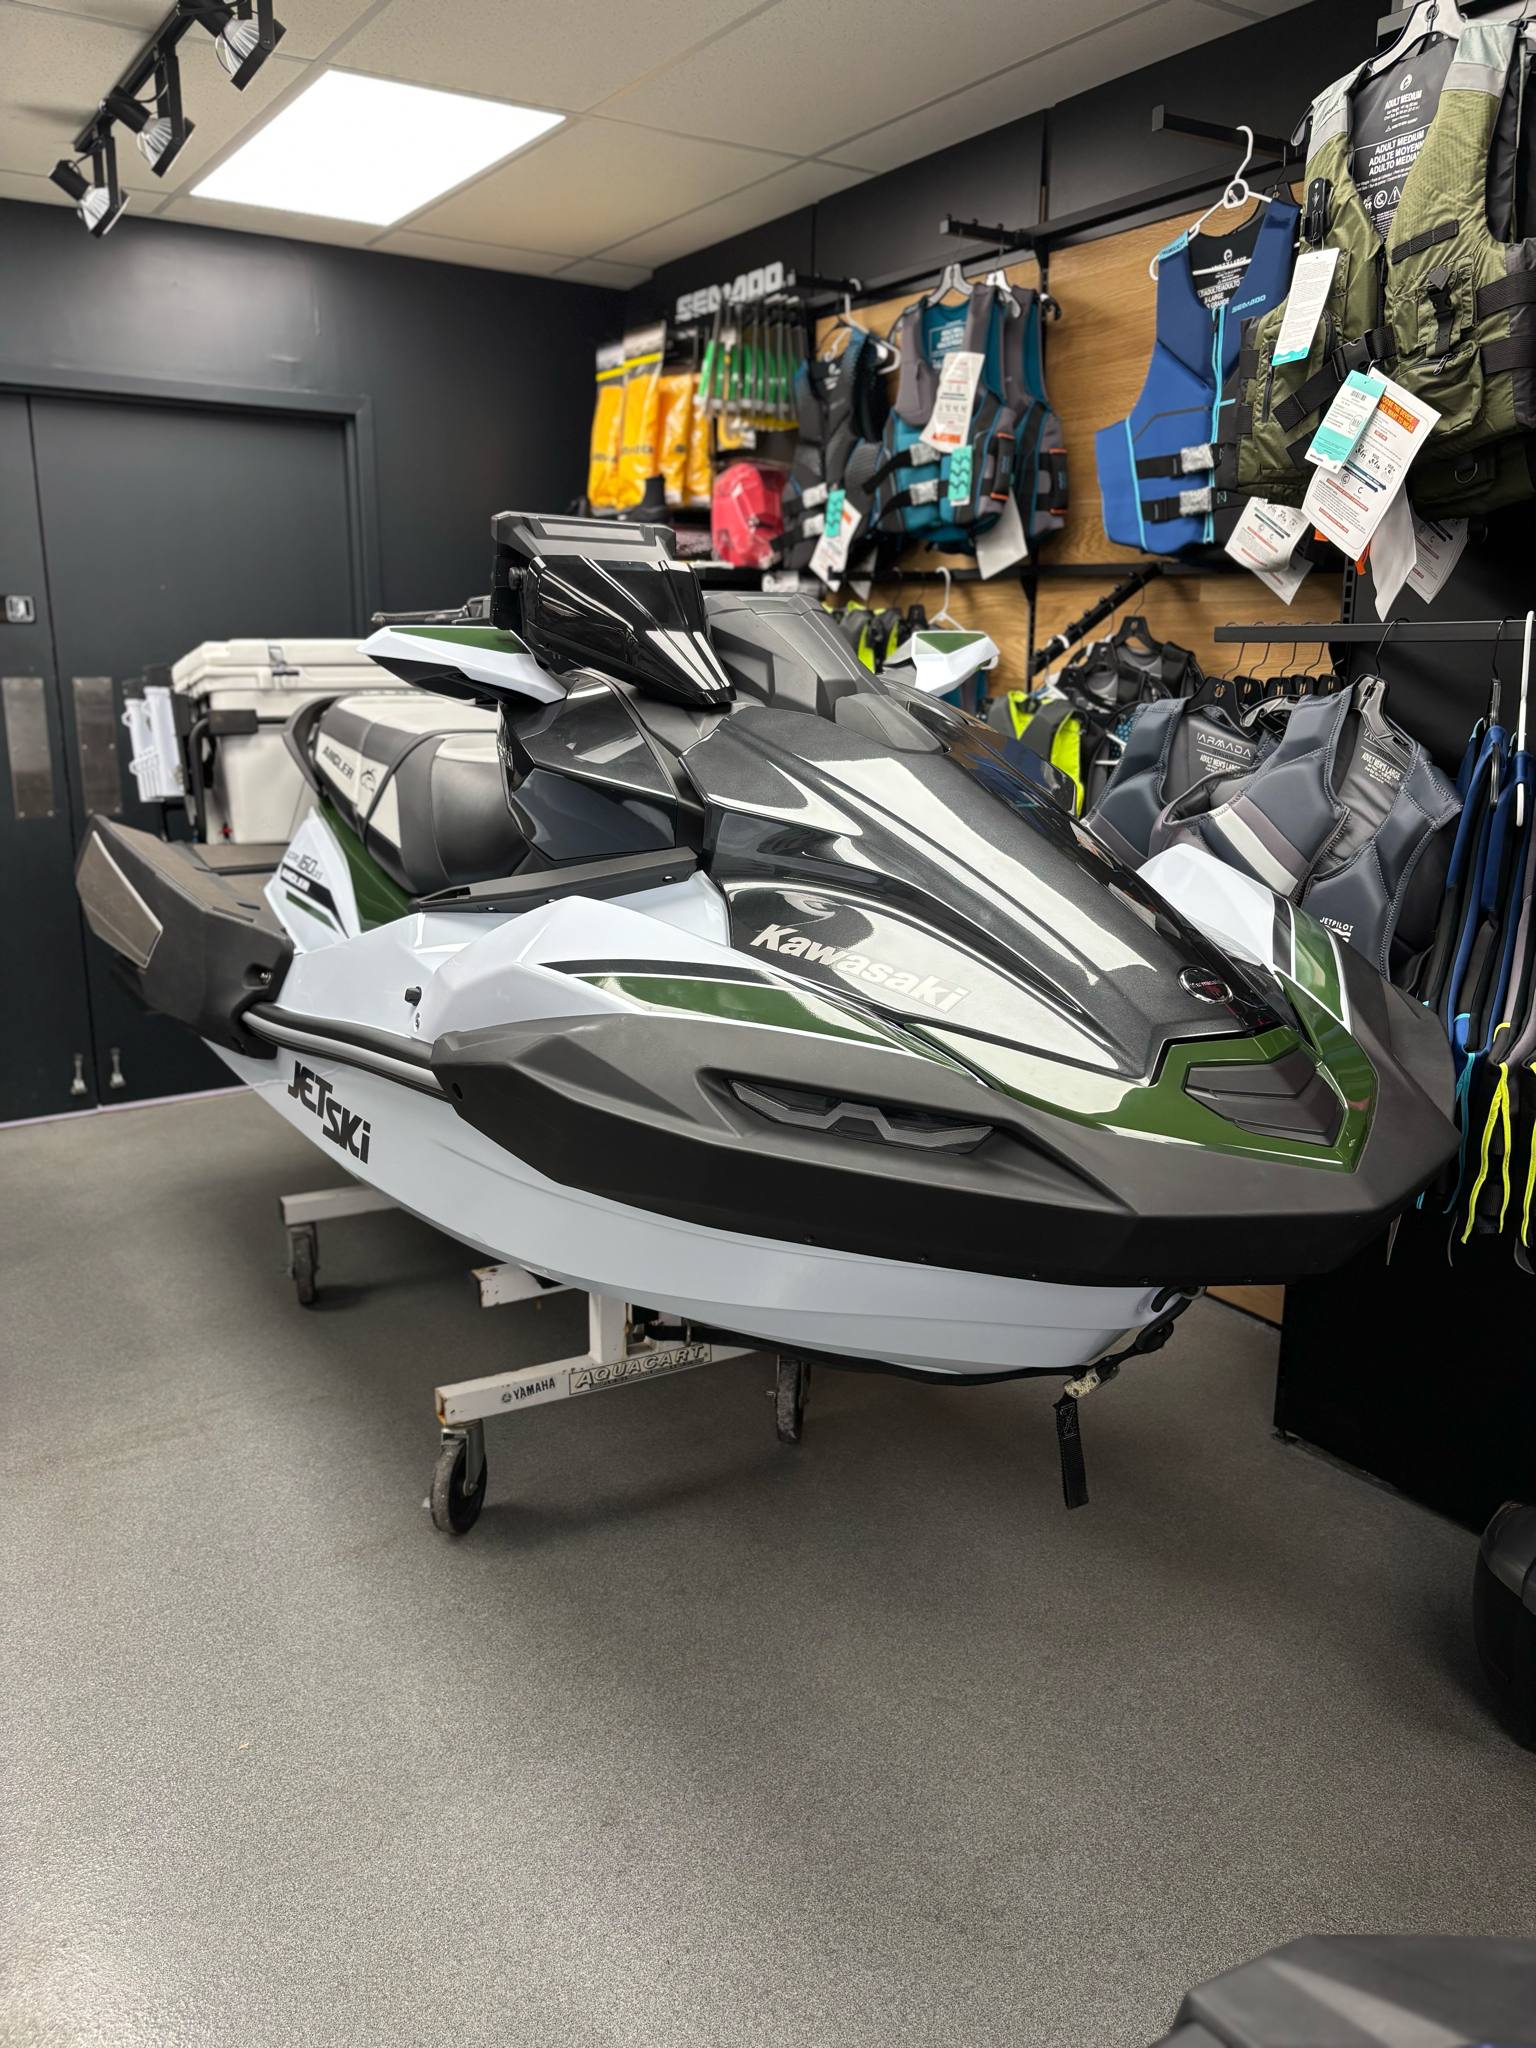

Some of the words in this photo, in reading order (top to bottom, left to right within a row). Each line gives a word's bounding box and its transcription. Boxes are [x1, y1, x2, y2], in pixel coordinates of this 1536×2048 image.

[1375, 139, 1398, 155] ADULT
[1396, 130, 1425, 148] MEDIUM
[1369, 150, 1395, 166] ADULTE
[1369, 161, 1396, 176] ADULTO
[1198, 732, 1251, 758] ARMADA
[322, 746, 354, 779] ANGLER
[1319, 917, 1354, 932] JETPILOT
[750, 923, 970, 1012] Kawasaki
[575, 1343, 704, 1388] AQUACART
[512, 1377, 555, 1400] YAMAHA
